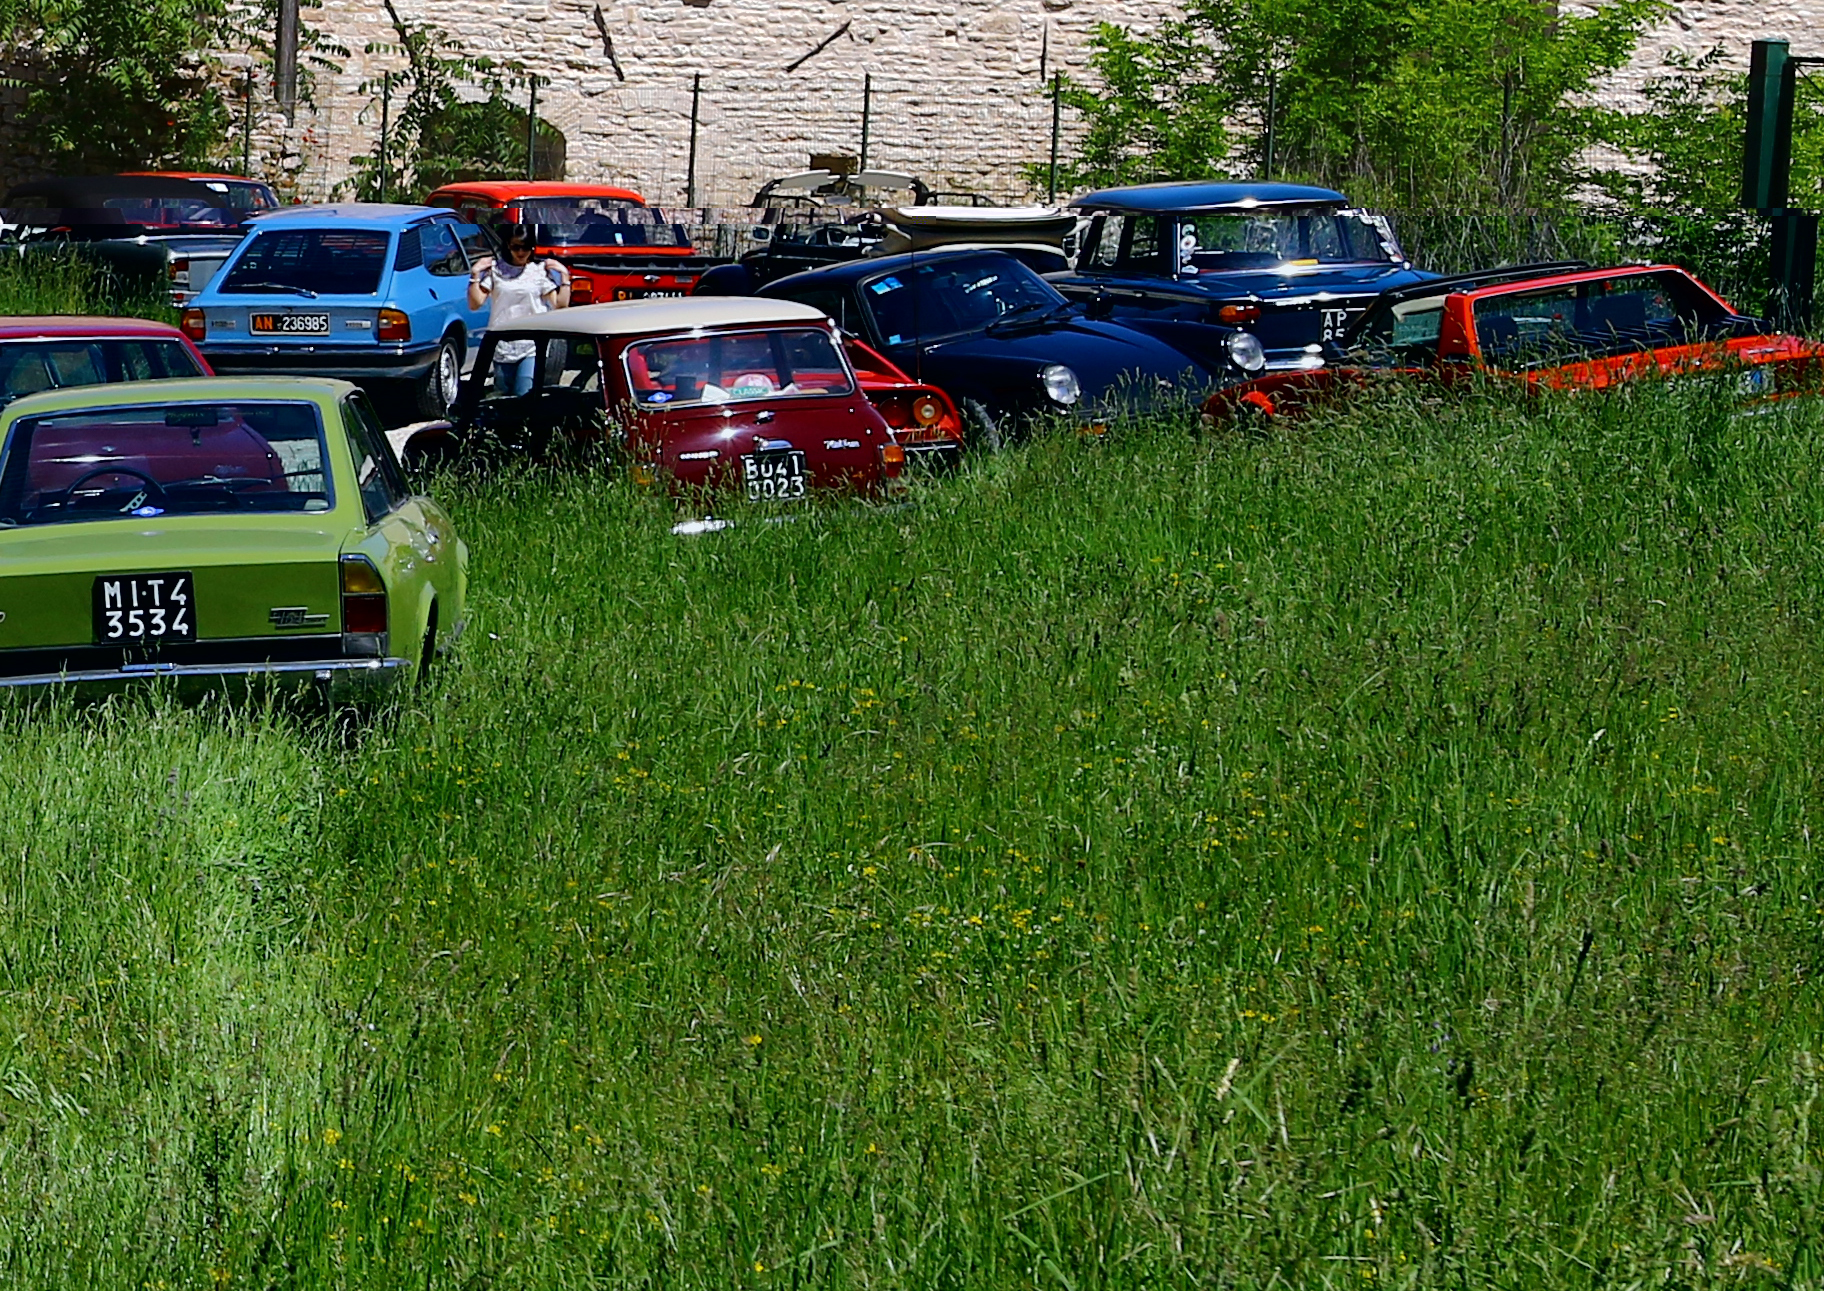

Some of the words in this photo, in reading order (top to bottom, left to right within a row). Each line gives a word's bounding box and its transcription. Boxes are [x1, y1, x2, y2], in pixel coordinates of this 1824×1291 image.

[255, 316, 273, 330] AN
[282, 316, 328, 331] 236985
[1323, 311, 1347, 328] AP
[105, 608, 189, 638] 3534
